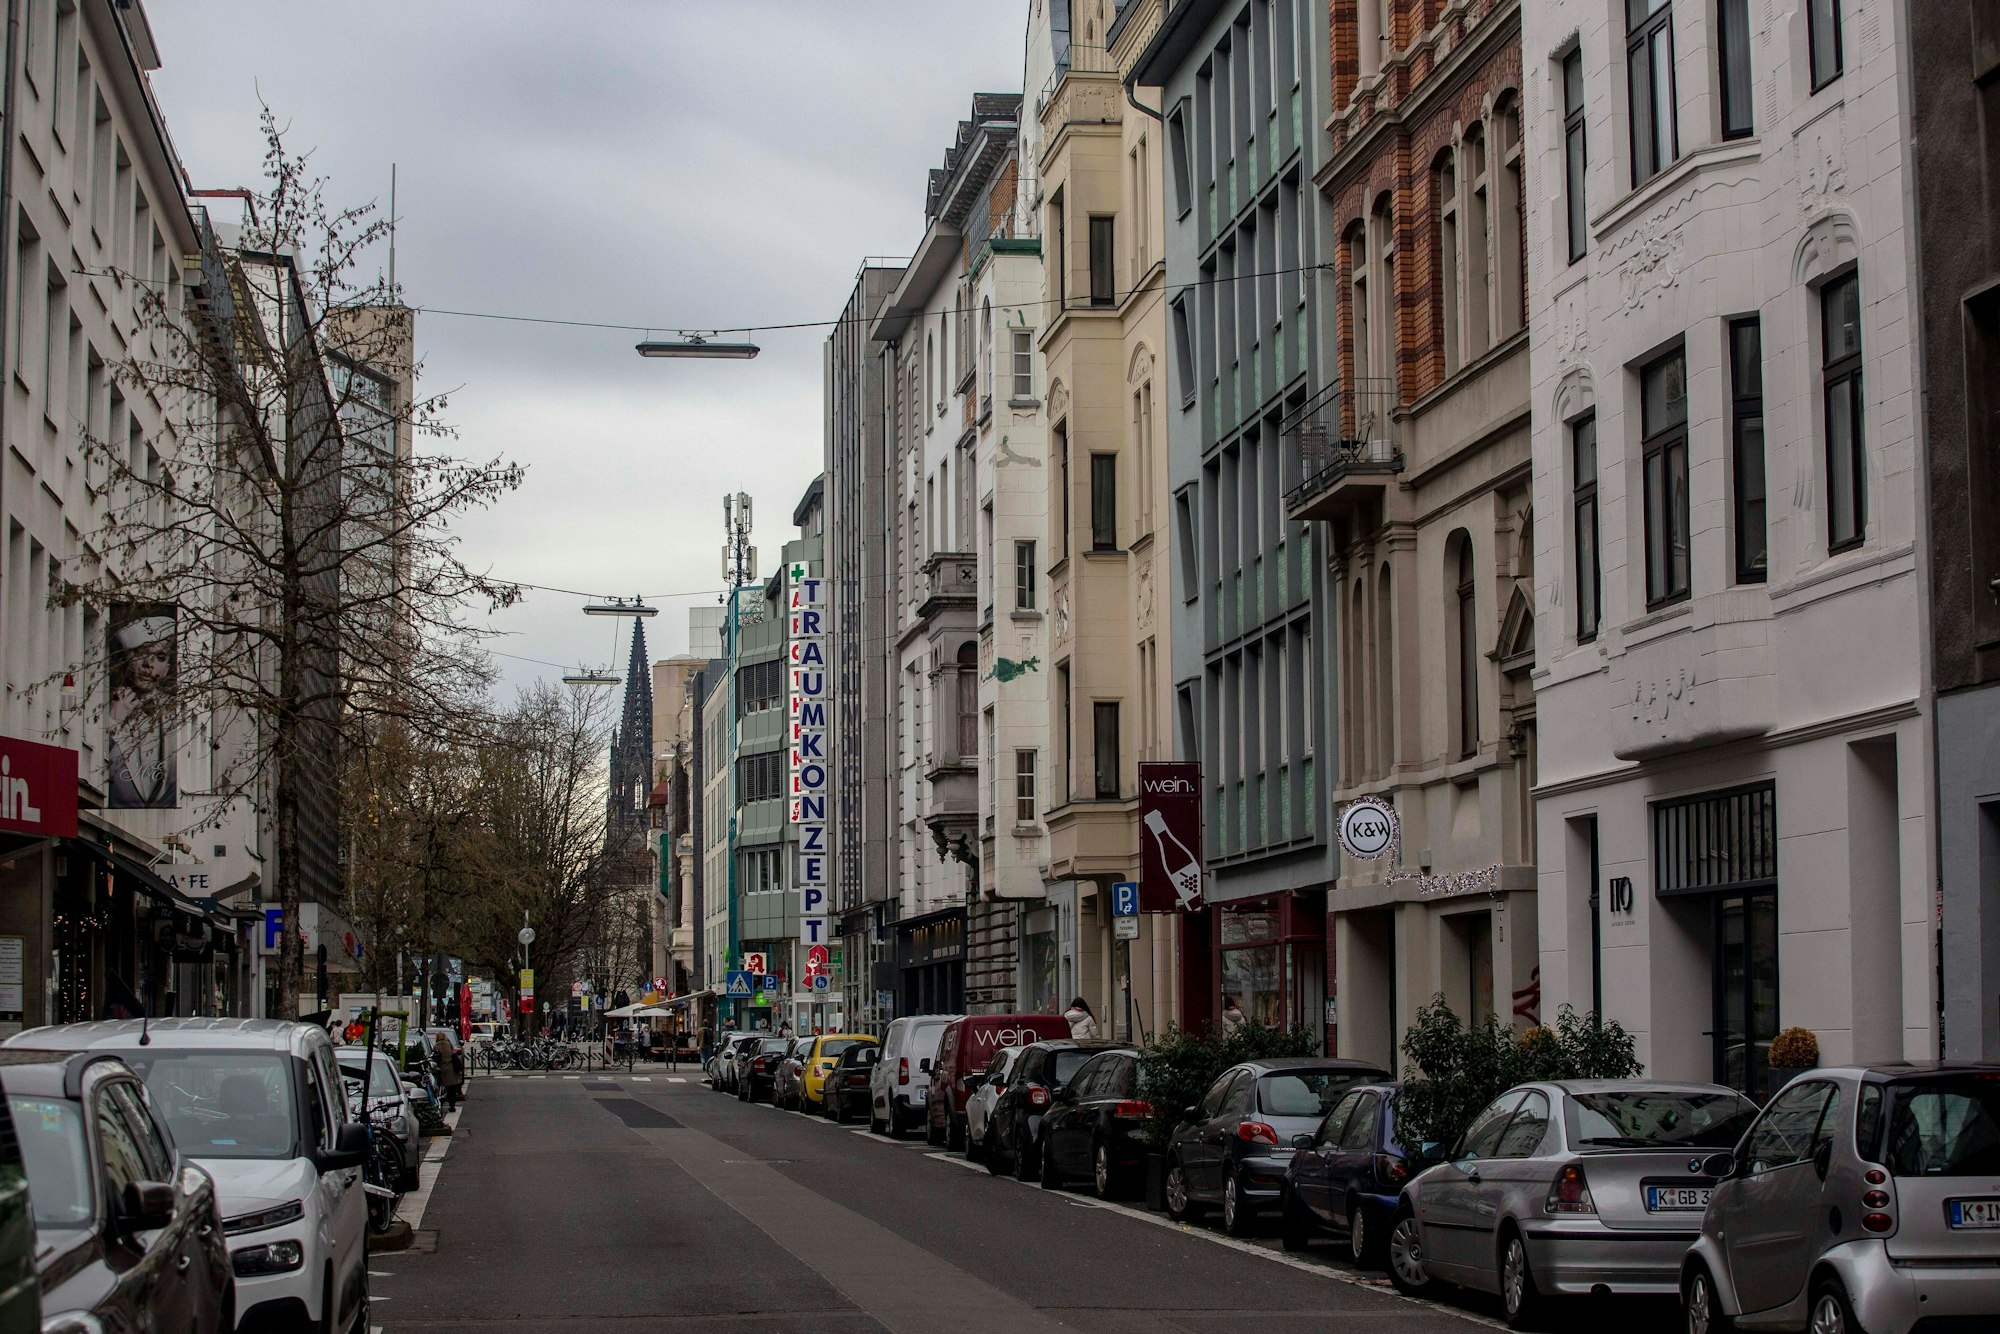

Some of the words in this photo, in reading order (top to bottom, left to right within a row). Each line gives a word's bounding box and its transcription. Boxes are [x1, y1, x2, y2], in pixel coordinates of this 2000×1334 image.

[801, 580, 825, 942] TRAUMKONZEPT
[1352, 821, 1390, 839] K&W
[188, 874, 209, 889] FE
[1118, 886, 1132, 911] P
[765, 976, 775, 989] P
[974, 1023, 1037, 1047] wein
[1658, 1190, 1668, 1205] K
[1678, 1190, 1697, 1205] GB
[1963, 1204, 1974, 1222] K
